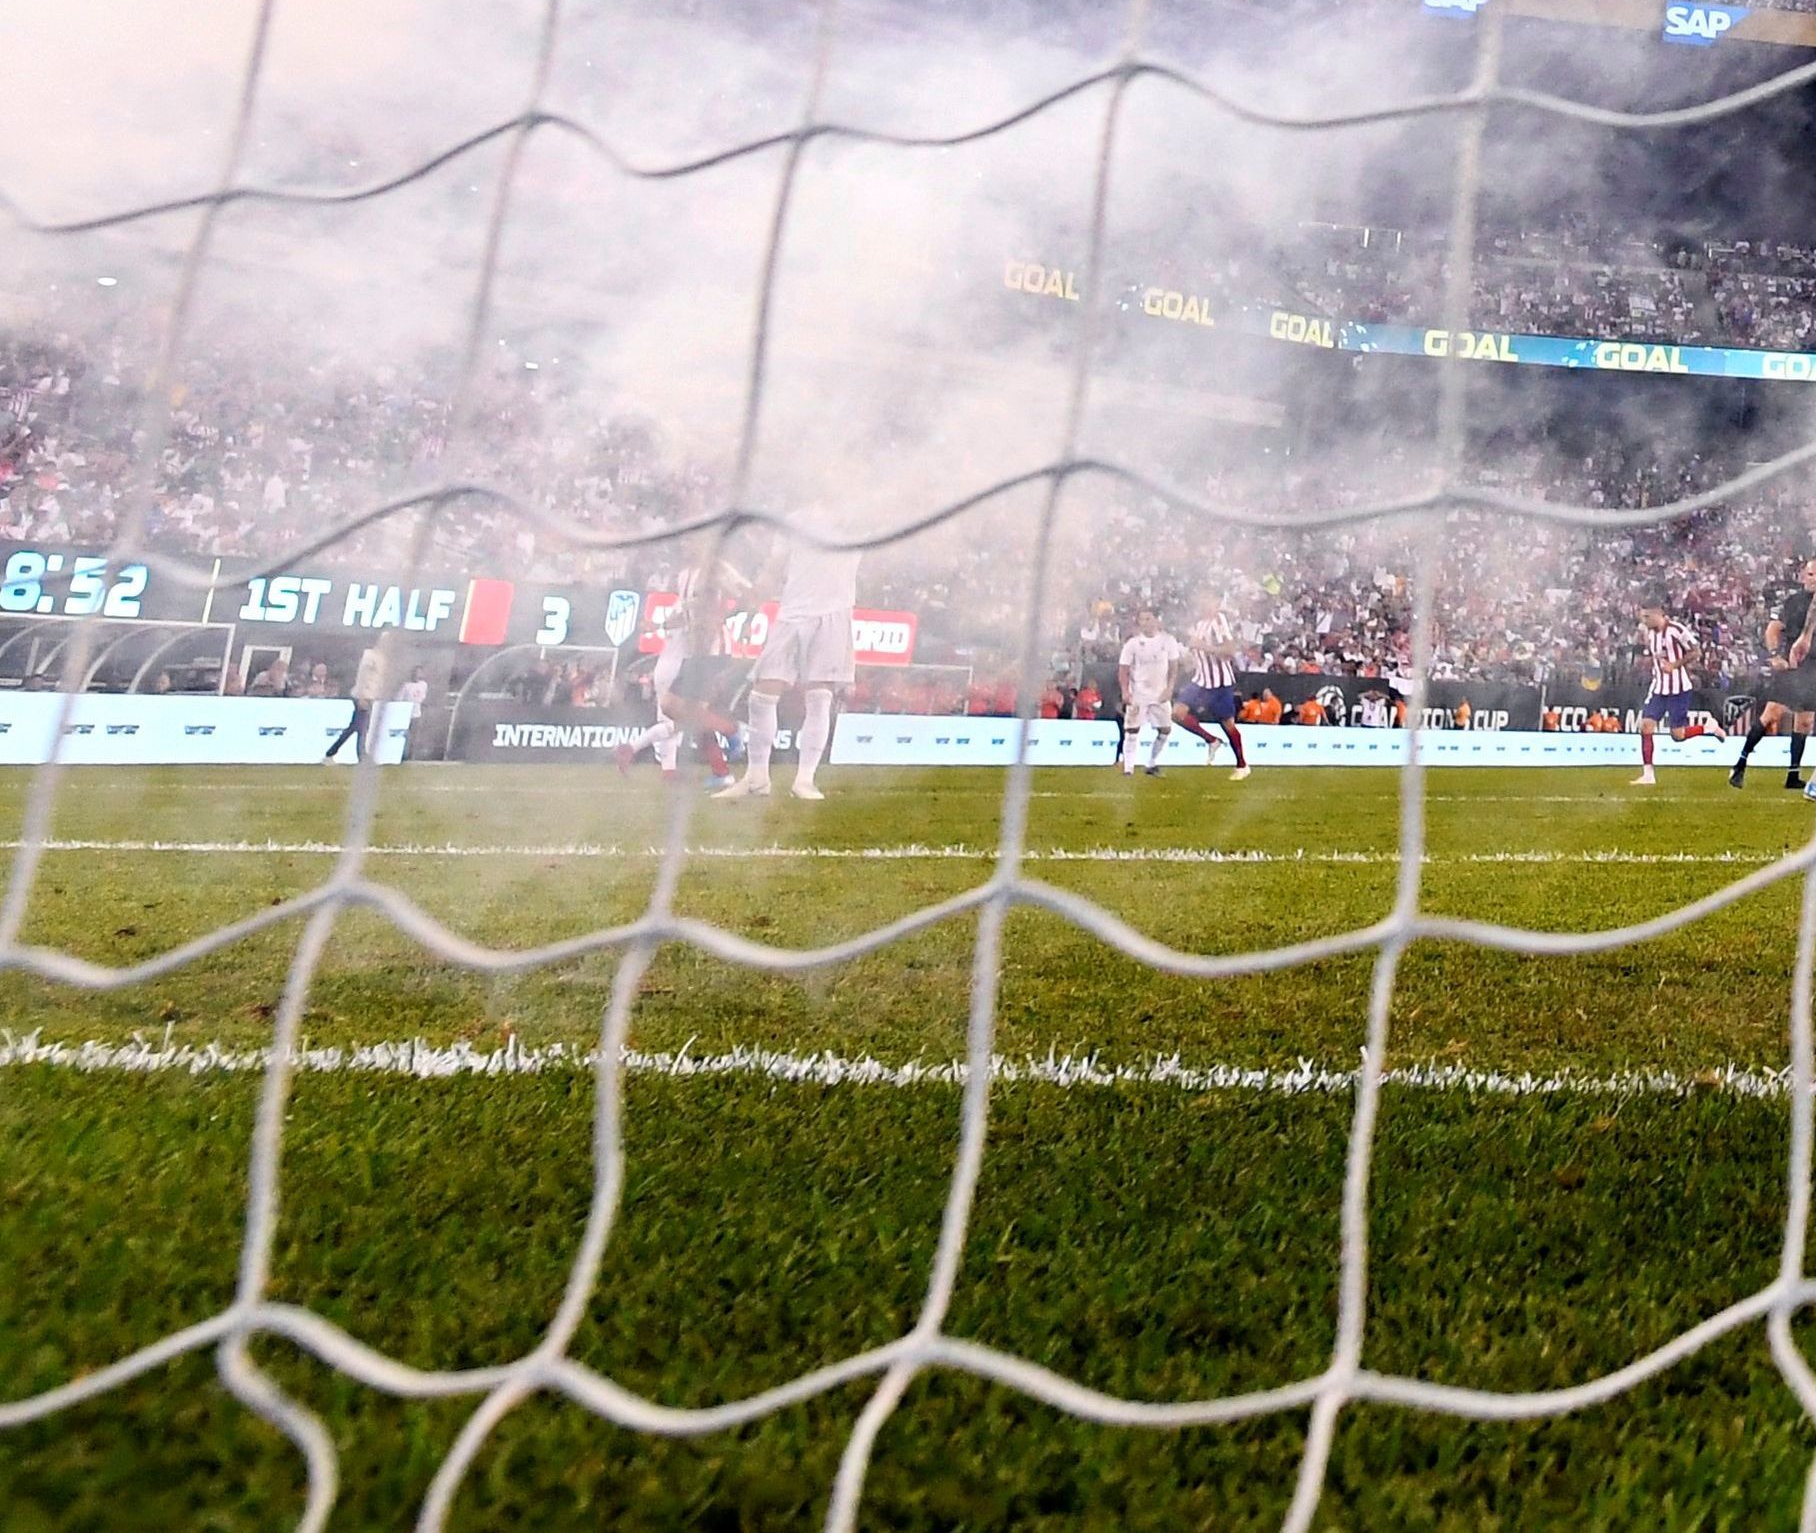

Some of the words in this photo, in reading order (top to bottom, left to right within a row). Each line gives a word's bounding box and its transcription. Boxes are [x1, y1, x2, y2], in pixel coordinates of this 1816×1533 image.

[1666, 6, 1731, 40] SAP
[1004, 259, 1079, 300] GOAL
[1143, 288, 1215, 327] GOAL
[1270, 312, 1334, 348] GOAL
[1423, 329, 1519, 363] GOAL
[1600, 341, 1689, 373] GOAL
[238, 577, 332, 624] 1ST
[342, 583, 456, 631] HALF
[536, 596, 570, 645] 3
[1473, 709, 1509, 732] CUP
